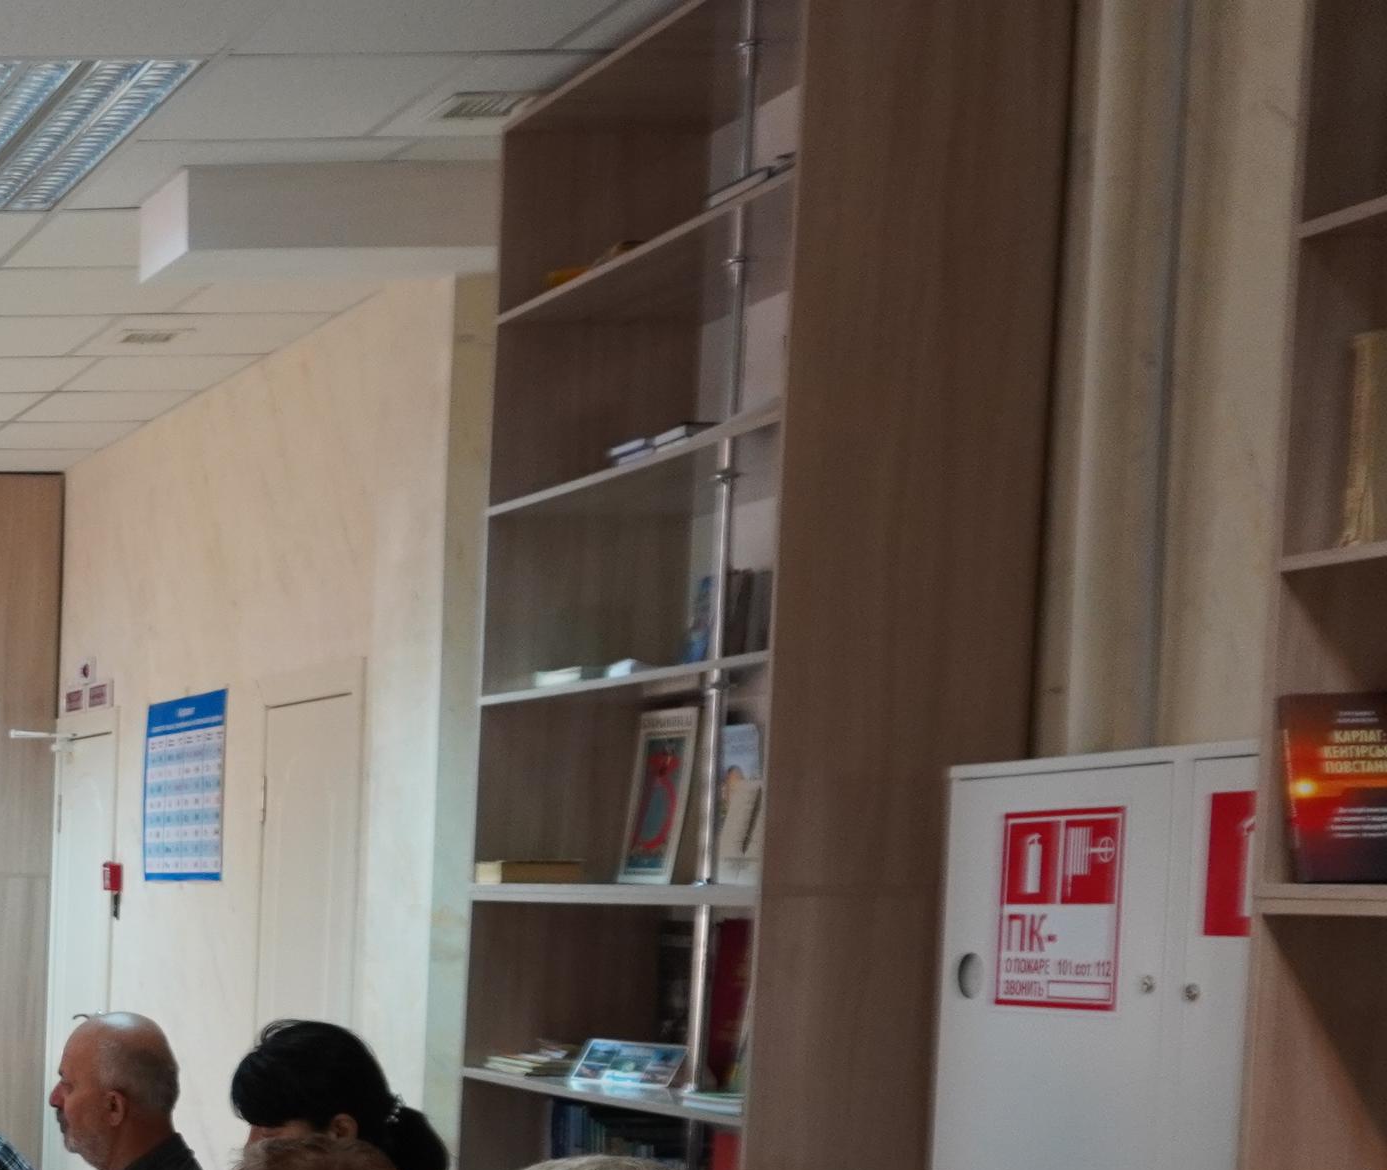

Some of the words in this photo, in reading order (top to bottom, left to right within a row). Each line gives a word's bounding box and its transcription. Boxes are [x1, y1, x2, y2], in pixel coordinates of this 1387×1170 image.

[1007, 913, 1058, 953] ПК-
[1014, 958, 1051, 976] ПОЖАРЕ
[1003, 979, 1045, 997] ЗВОНИТЬ
